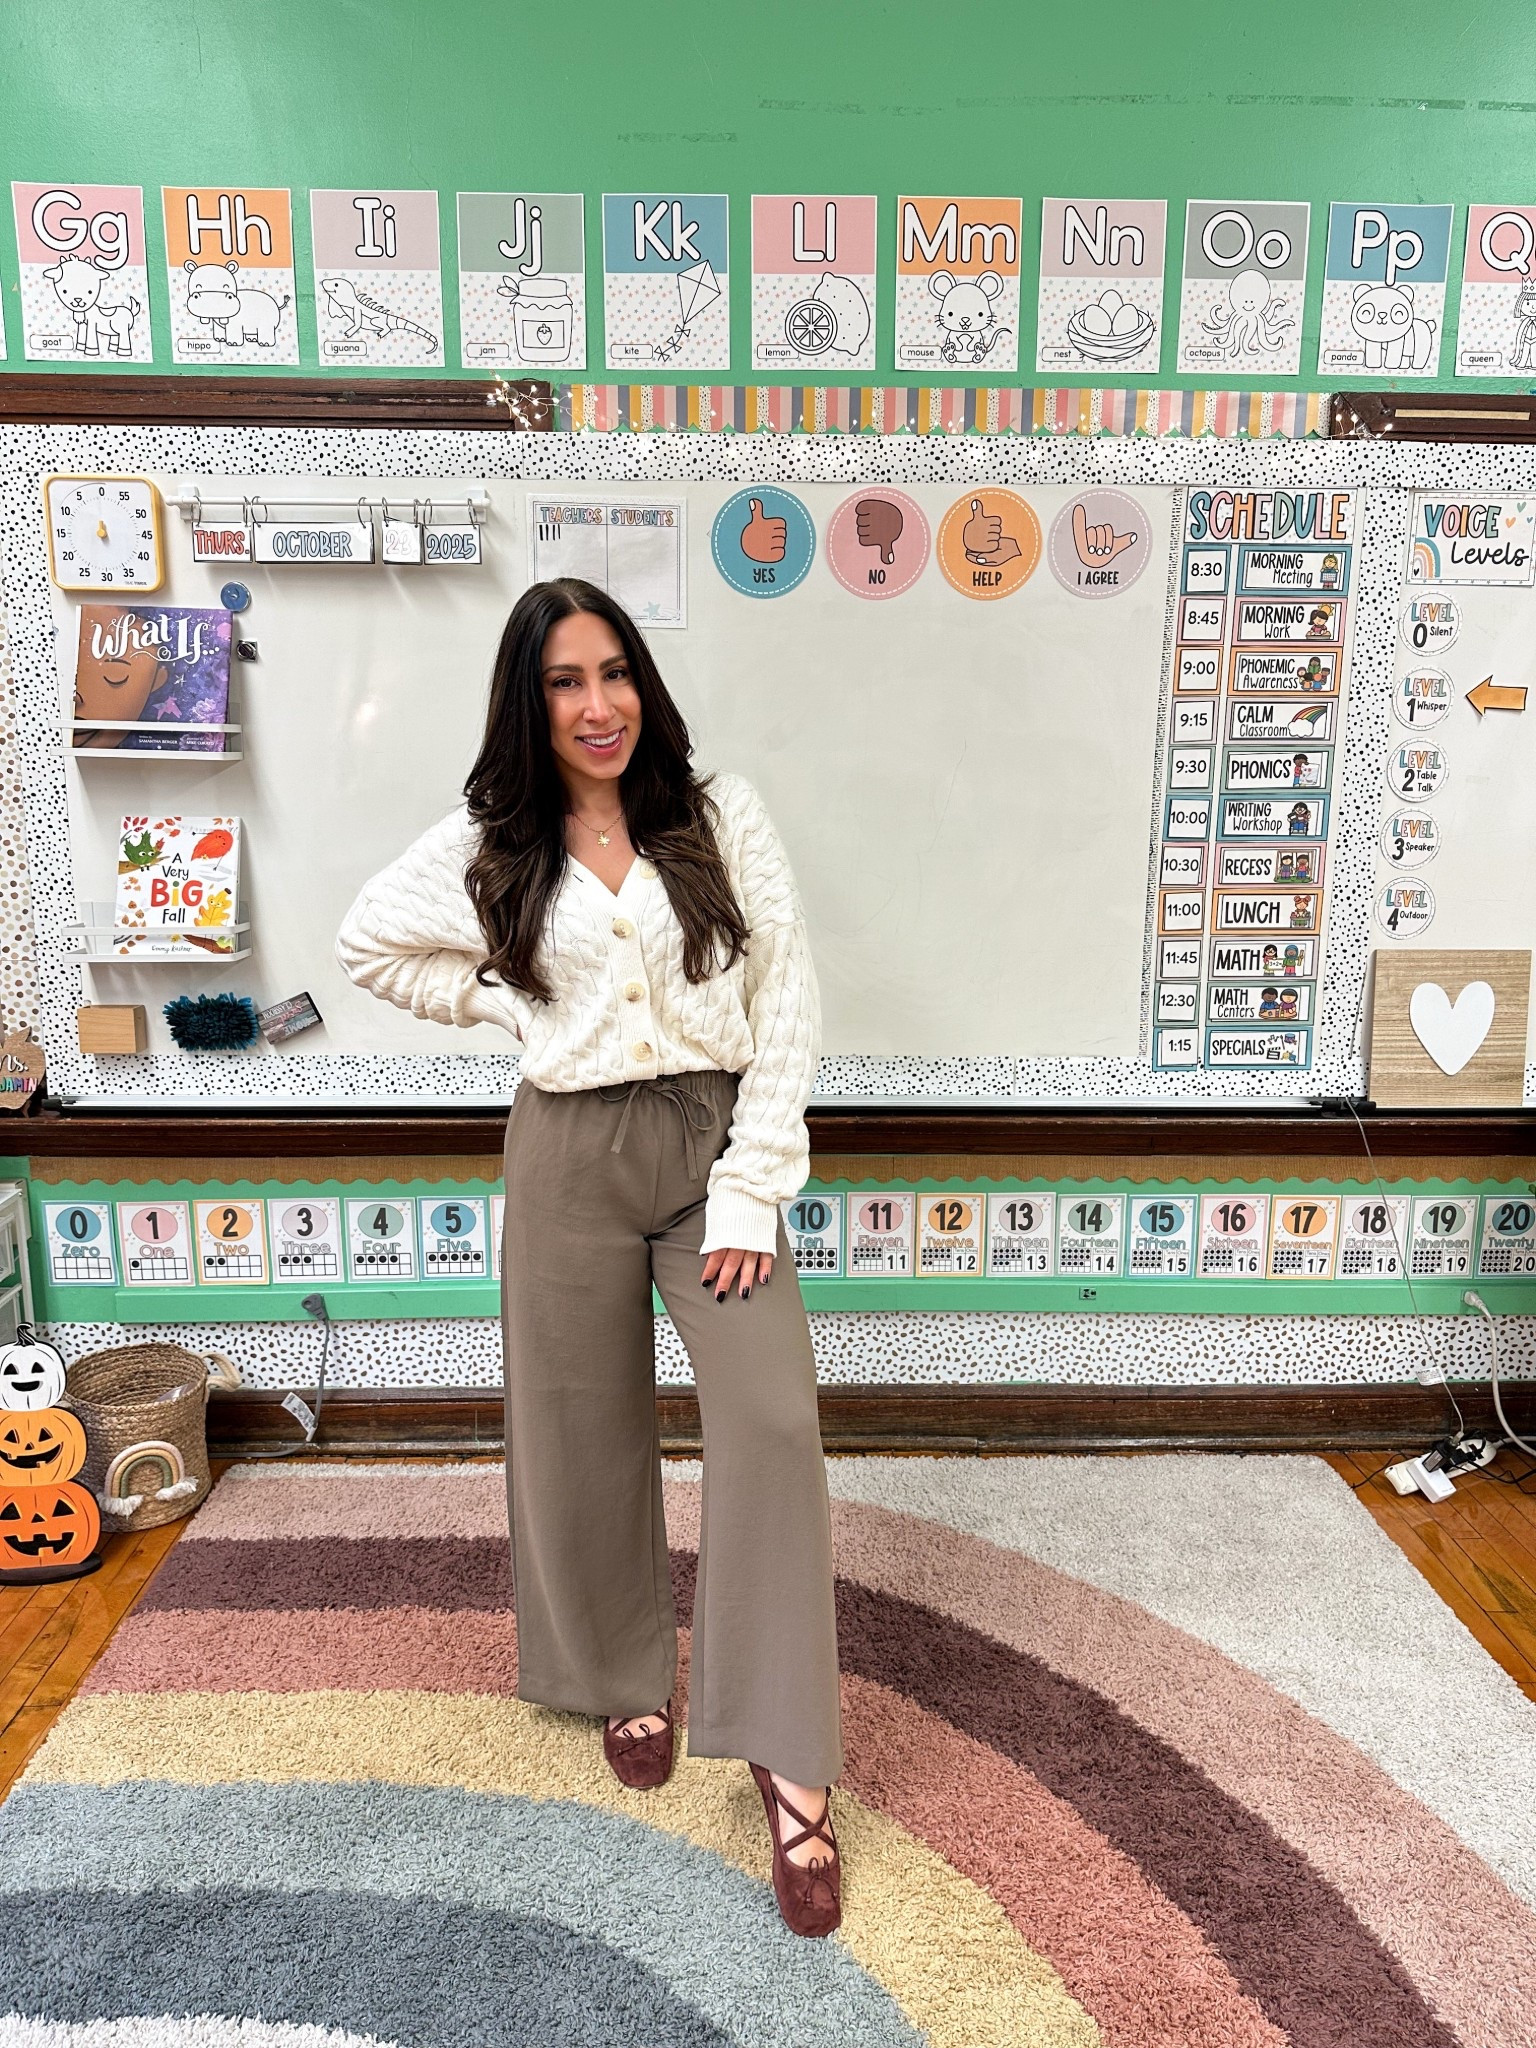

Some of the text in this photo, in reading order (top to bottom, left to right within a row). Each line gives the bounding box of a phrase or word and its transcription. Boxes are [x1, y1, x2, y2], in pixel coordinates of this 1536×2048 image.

[32, 190, 129, 270] Gg
[186, 194, 272, 256] Hh
[353, 197, 397, 258] Ii
[634, 201, 701, 261] Kk
[793, 202, 837, 262] Ll
[498, 198, 543, 276] Jj
[903, 203, 1016, 263] Mm
[1063, 206, 1144, 266] Nn
[1201, 210, 1292, 269] Oo
[1350, 210, 1424, 286] Pp
[42, 337, 62, 348] goat
[187, 341, 211, 352] hippo
[331, 343, 360, 354] iguana
[479, 345, 496, 356] jam
[624, 346, 640, 355] kite
[765, 348, 790, 357] lemon
[907, 349, 934, 357] mouse
[1189, 349, 1221, 359] octopus
[1331, 353, 1357, 363] panda
[1469, 356, 1494, 364] queen
[76, 491, 82, 500] 5
[99, 487, 105, 497] 0
[119, 491, 130, 501] 55
[61, 506, 70, 516] 10
[135, 509, 147, 518] 50
[540, 507, 674, 526] TEACHERS STUDENTS
[1189, 491, 1350, 540] SCHEDULE
[1424, 504, 1502, 538] VOICE
[57, 529, 66, 538] 15
[141, 530, 153, 540] 45
[194, 531, 250, 555] THURS.
[273, 531, 351, 558] OCTOBER
[427, 534, 476, 560] 2025
[63, 552, 74, 561] 20
[138, 551, 150, 561] 40
[1250, 553, 1303, 569] MORNING
[1450, 541, 1529, 567] Levels
[79, 568, 91, 577] 25
[123, 569, 134, 578] 35
[753, 567, 776, 584] YES
[868, 569, 886, 585] NO
[1191, 563, 1222, 576] 8:30
[101, 573, 113, 582] 30
[972, 571, 1003, 587] HELP
[1078, 571, 1120, 586] I AGREE
[1273, 569, 1313, 587] Meeting
[1188, 611, 1219, 625] 8:45
[1244, 606, 1305, 624] MORNING
[1411, 603, 1454, 622] LEVEL
[91, 613, 172, 659] What
[1264, 624, 1290, 638] Work
[1413, 623, 1454, 648] 0 Silent
[1183, 661, 1215, 675] 9:00
[1240, 658, 1295, 674] PHONEMIC
[1243, 675, 1298, 689] Awareness
[1404, 678, 1447, 698] LEVEL
[1238, 706, 1273, 723] CALM
[1406, 698, 1447, 722] 1 Whisper
[1180, 713, 1208, 727] 9:15
[1240, 724, 1288, 736] Classroom
[1176, 760, 1207, 774] 9:30
[1399, 750, 1441, 769] LEVEL
[1231, 760, 1292, 779] PHONICS
[1401, 769, 1437, 792] 2 Table
[1417, 783, 1433, 792] Talk
[1228, 803, 1272, 816] WRITING
[1171, 811, 1207, 824] 10:00
[1233, 818, 1282, 834] Workshop
[1392, 819, 1434, 838] LEVEL
[1392, 837, 1435, 860] 3 Speaker
[172, 852, 182, 864] A
[1164, 859, 1199, 871] 10:30
[162, 866, 189, 880] Very
[1225, 858, 1272, 876] RECESS
[1386, 889, 1427, 908] LEVEL
[162, 908, 186, 924] Fall
[1167, 903, 1200, 916] 11:00
[1225, 901, 1280, 924] LUNCH
[1387, 908, 1428, 931] 4 Outdoor
[1165, 951, 1198, 964] 11:45
[1216, 949, 1260, 971] MATH
[1160, 994, 1195, 1007] 12:30
[1214, 989, 1248, 1006] MATH
[1217, 1005, 1254, 1018] Centers
[1168, 1039, 1192, 1052] 1:15
[1212, 1040, 1266, 1056] SPECIALS
[222, 1208, 238, 1237] 2
[296, 1207, 313, 1237] 3
[373, 1207, 389, 1236] 4
[445, 1206, 462, 1233] 5
[795, 1202, 825, 1230] 10
[868, 1202, 892, 1230] 11
[935, 1202, 962, 1231] 12
[1005, 1203, 1034, 1231] 13
[1075, 1204, 1102, 1232] 14
[1146, 1205, 1174, 1233] 15
[1218, 1203, 1246, 1232] 16
[1290, 1206, 1318, 1233] 17
[1359, 1206, 1386, 1233] 18
[1429, 1206, 1457, 1233] 19
[1498, 1203, 1530, 1231] 20
[69, 1210, 88, 1239] 0
[146, 1211, 160, 1240] 1
[282, 1241, 331, 1254] Three
[362, 1240, 401, 1254] Four
[437, 1238, 472, 1252] Five
[795, 1235, 823, 1248] Ten
[858, 1235, 904, 1247] Eleven
[925, 1236, 974, 1248] Twelve
[992, 1236, 1049, 1248] Thirteen
[1060, 1236, 1119, 1248] Fourteen
[1136, 1237, 1186, 1250] Fifteen
[1207, 1237, 1258, 1249] Sixteen
[1273, 1239, 1332, 1249] Seventeen
[1345, 1237, 1398, 1250] Eighteen
[1414, 1238, 1469, 1249] Nineteen
[1488, 1237, 1535, 1249] Twenty
[61, 1244, 101, 1258] Zero
[139, 1245, 175, 1258] One
[214, 1242, 249, 1256] Two
